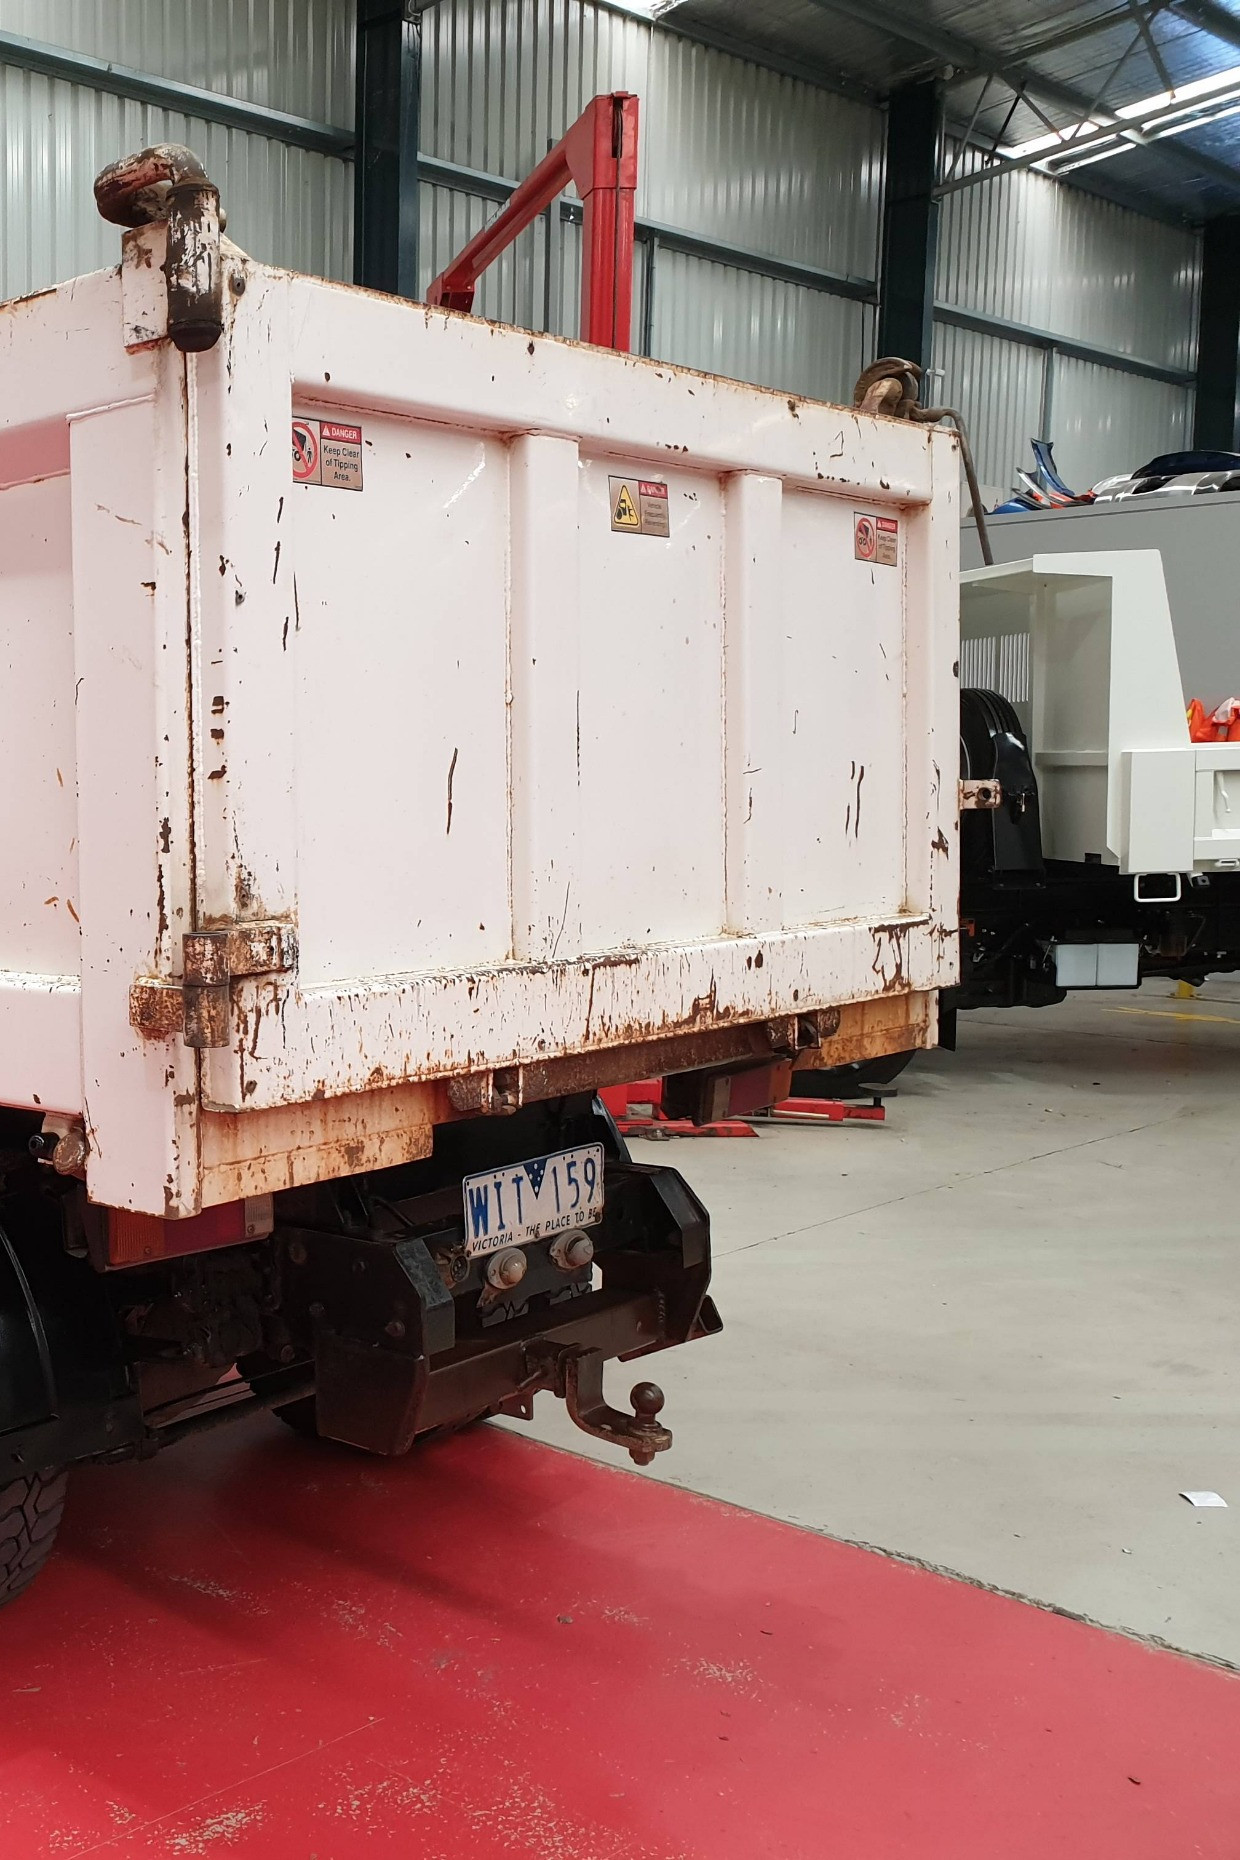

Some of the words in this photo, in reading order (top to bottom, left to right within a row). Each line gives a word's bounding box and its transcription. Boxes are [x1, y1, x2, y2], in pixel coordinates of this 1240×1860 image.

[331, 427, 357, 439] DANGER
[323, 445, 341, 457] Keep
[342, 447, 360, 458] Clear
[325, 459, 332, 467] of
[333, 459, 359, 473] Tipping
[333, 471, 351, 481] Area.
[468, 1176, 524, 1239] WIT
[551, 1157, 597, 1214] 159
[471, 1231, 514, 1252] VICTORIA
[525, 1223, 541, 1237] THE
[545, 1214, 571, 1232] PLACE
[574, 1211, 585, 1224] TO
[587, 1207, 598, 1219] BE
